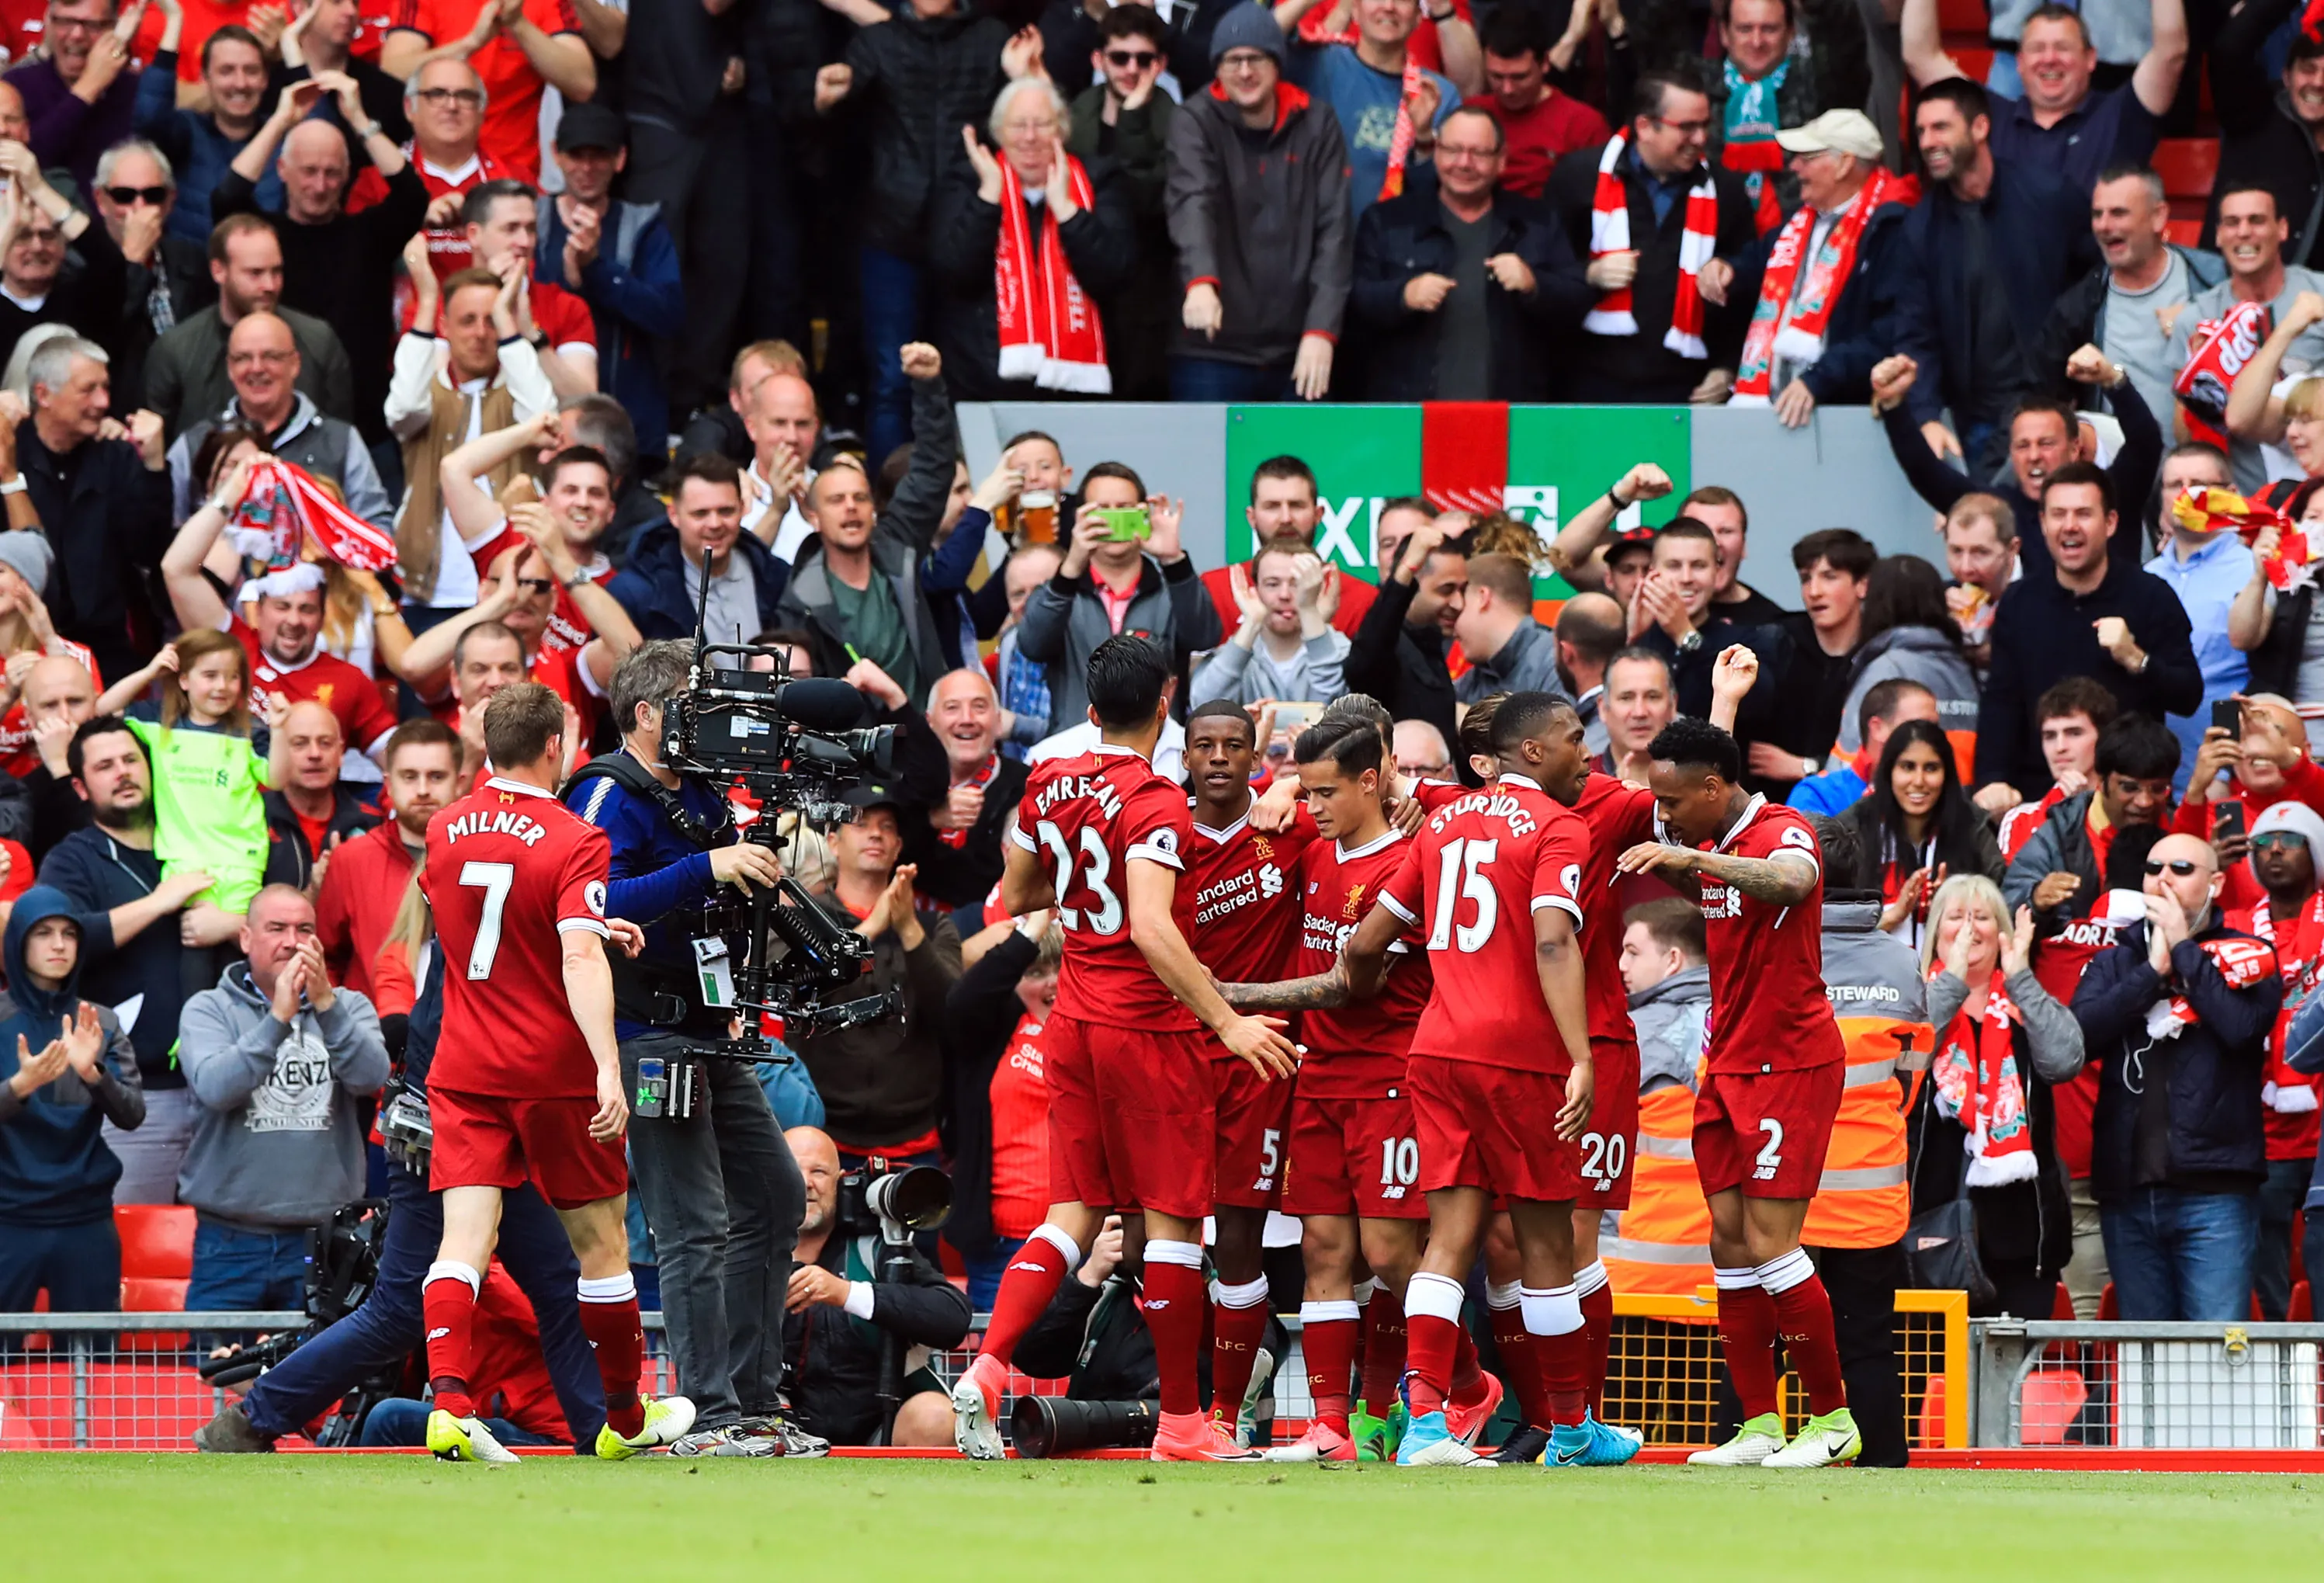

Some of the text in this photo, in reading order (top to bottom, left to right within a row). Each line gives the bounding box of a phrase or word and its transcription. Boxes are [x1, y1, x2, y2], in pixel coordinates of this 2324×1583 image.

[446, 811, 546, 848] MILNER
[1035, 820, 1123, 936] 23
[1426, 836, 1500, 954] 15
[458, 860, 514, 981] 7
[1825, 985, 1900, 1003] STEWARD
[269, 1061, 334, 1087] KENZ
[1260, 1128, 1280, 1176] 5
[1380, 1137, 1419, 1186] 10
[1580, 1132, 1625, 1179] 20
[1756, 1118, 1784, 1167] 2
